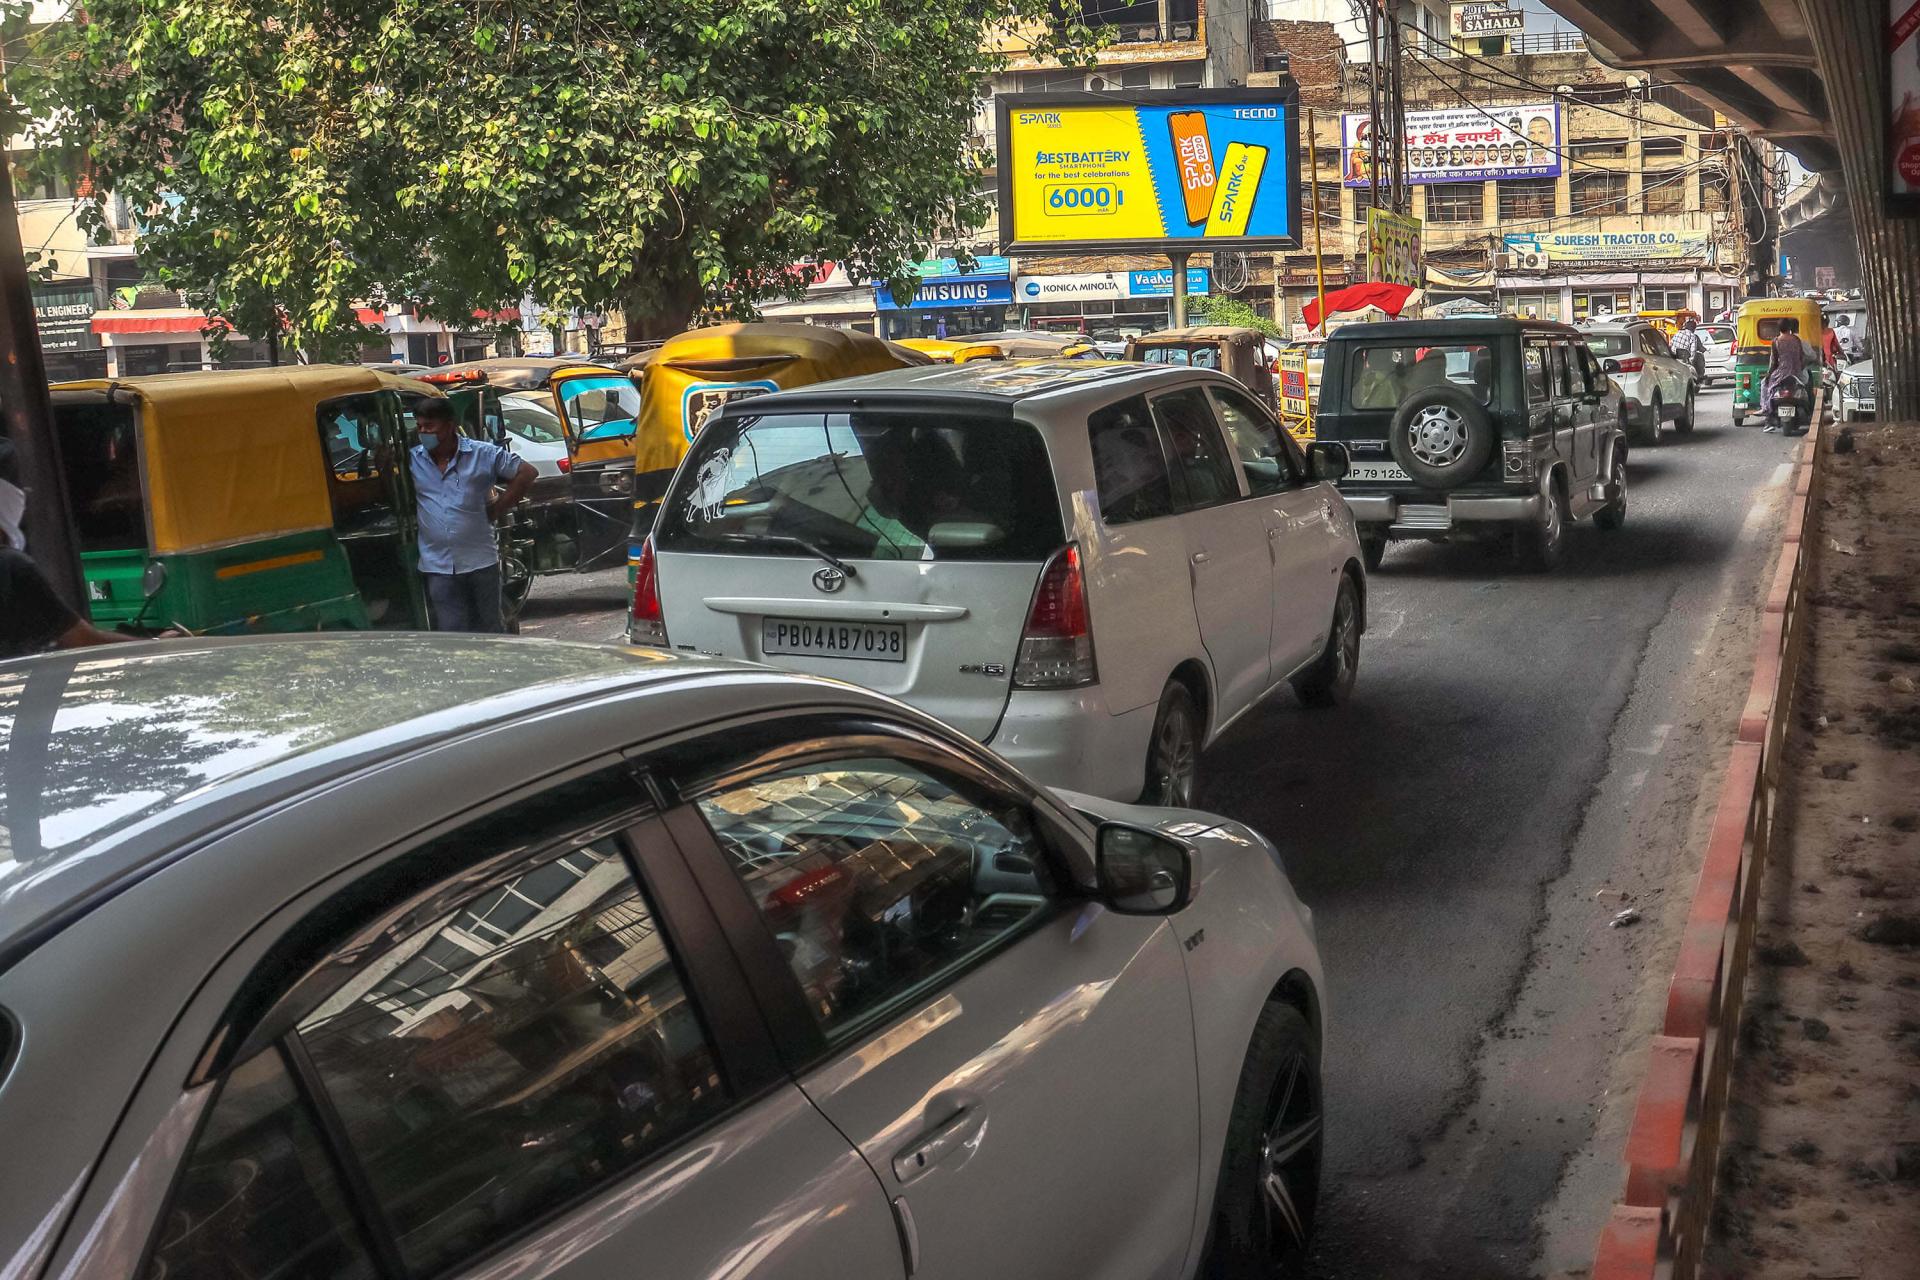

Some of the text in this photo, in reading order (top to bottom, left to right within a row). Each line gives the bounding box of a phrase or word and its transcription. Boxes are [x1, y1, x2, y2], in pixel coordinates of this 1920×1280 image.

[1466, 17, 1521, 31] SAHARA
[1020, 113, 1061, 124] SPARK
[1233, 108, 1277, 119] TECNO
[1036, 150, 1130, 165] BESTBATTERY
[1179, 136, 1202, 190] SPARK
[1195, 137, 1214, 187] Go 2020
[1083, 170, 1130, 178] celebrations
[1049, 187, 1111, 208] 6000
[1220, 171, 1244, 223] SPARK
[1236, 163, 1245, 172] 6
[1554, 233, 1679, 246] SURESH TRACTOR CO.
[912, 283, 988, 301] MSUNG
[1043, 282, 1118, 293] KONICA MINOLTA
[47, 303, 94, 317] ENGINEER's
[1364, 469, 1378, 478] 79
[777, 623, 900, 653] PB04AB7038
